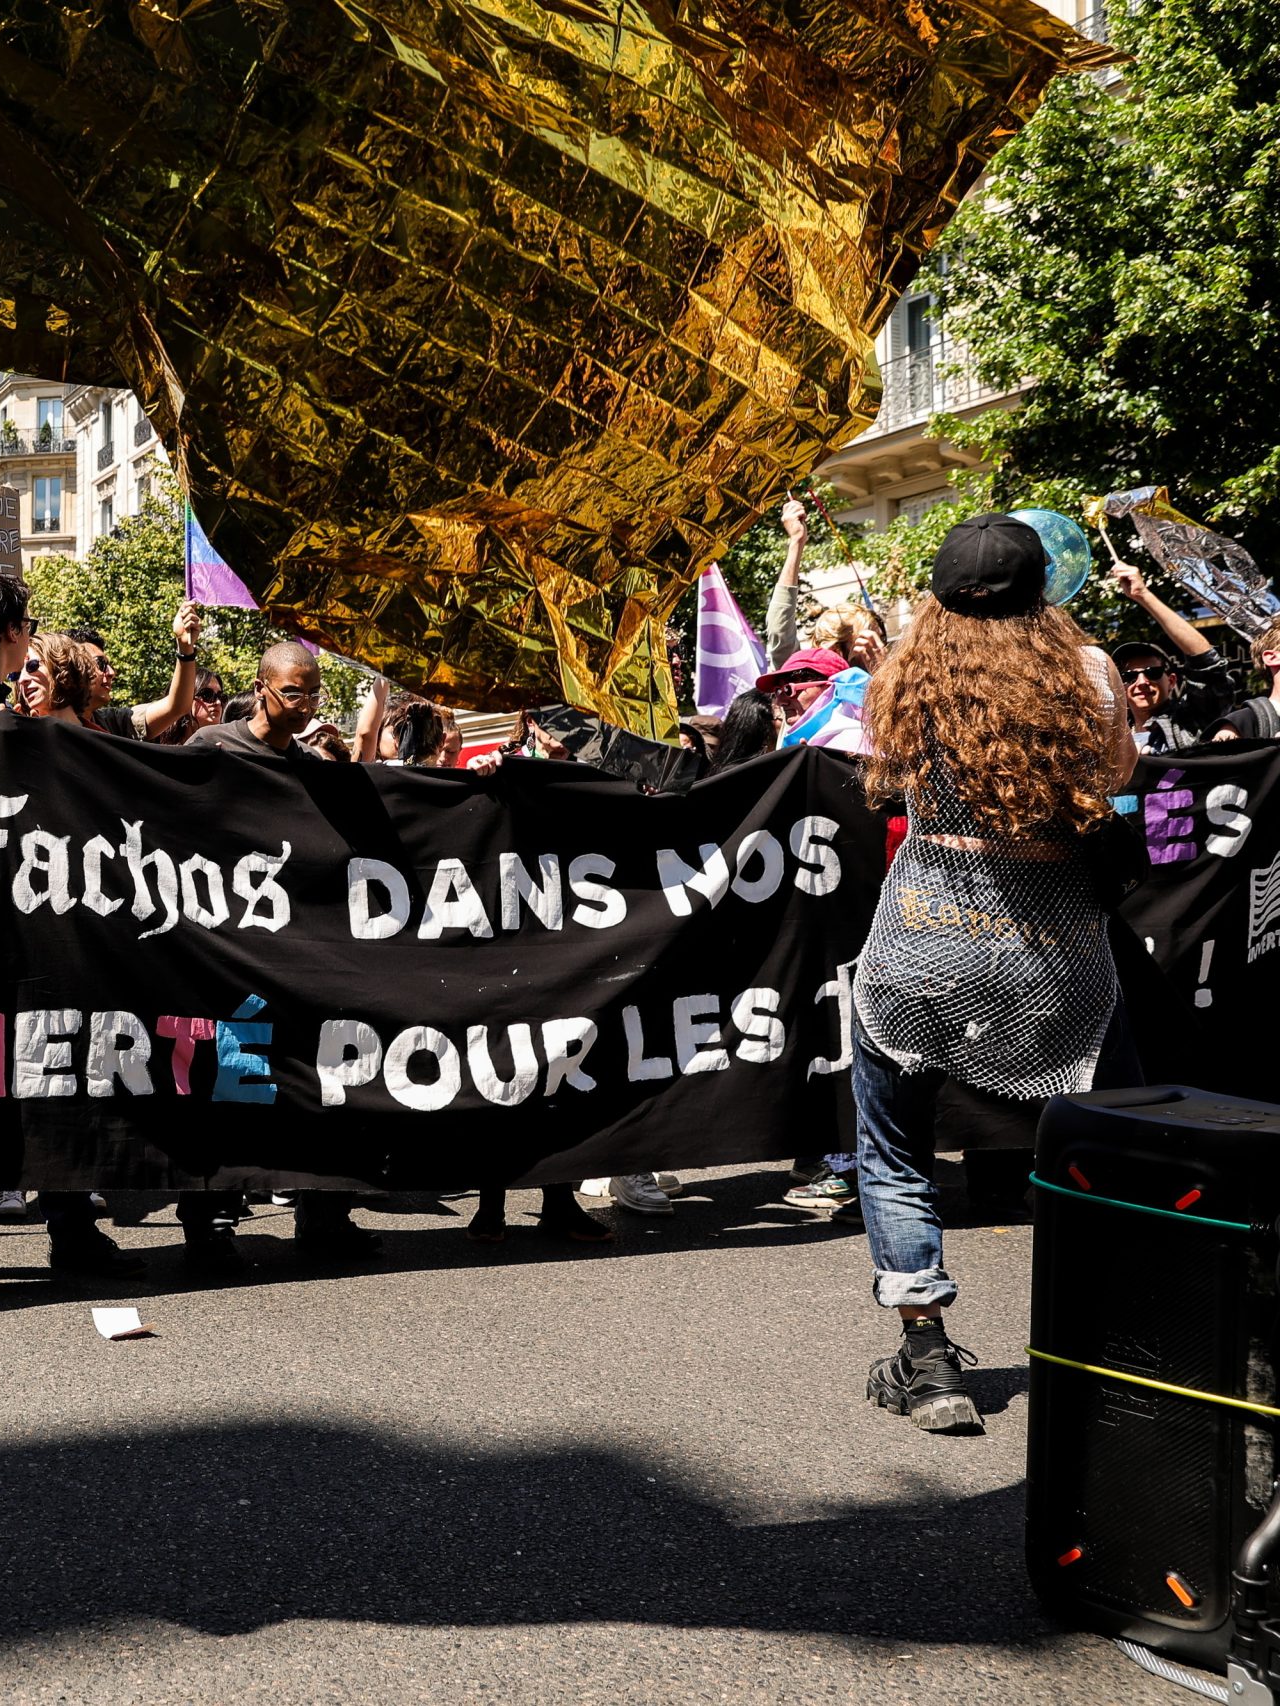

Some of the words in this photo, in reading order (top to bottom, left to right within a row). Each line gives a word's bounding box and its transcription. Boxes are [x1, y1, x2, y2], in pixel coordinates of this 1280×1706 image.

[348, 852, 627, 940] DANS
[656, 815, 842, 917] NOS
[316, 1016, 599, 1112] POUR
[622, 988, 786, 1082] LES
